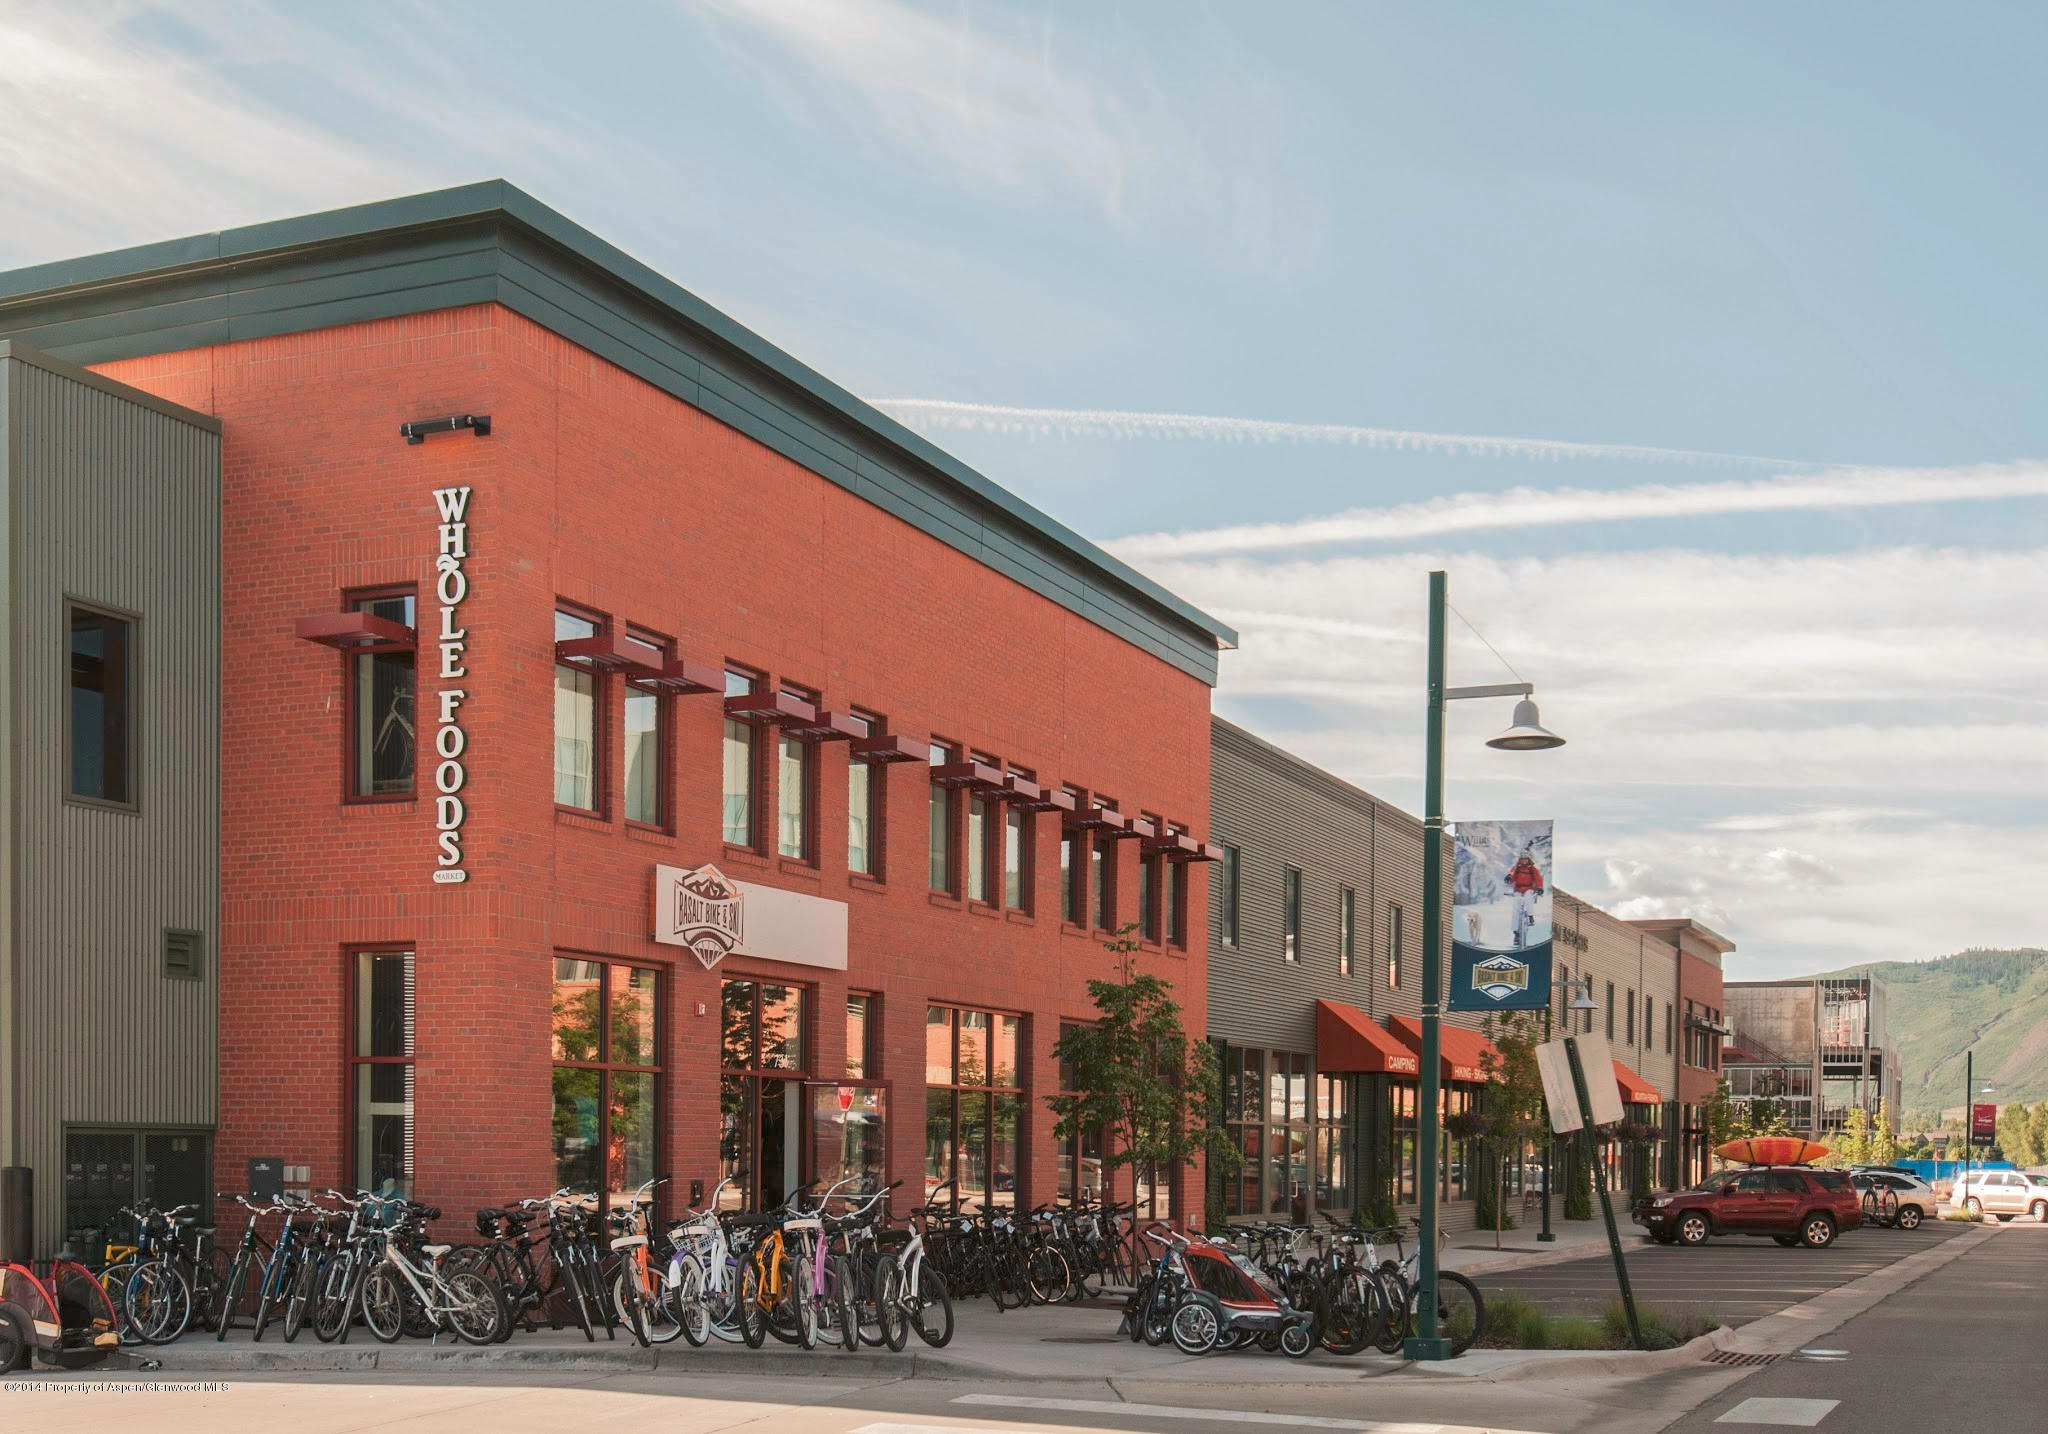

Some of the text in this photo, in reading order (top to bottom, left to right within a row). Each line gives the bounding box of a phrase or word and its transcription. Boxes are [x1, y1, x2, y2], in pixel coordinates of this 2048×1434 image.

[432, 486, 471, 867] WHOLE FOODS
[435, 872, 464, 881] MARKET
[679, 891, 704, 926] BASALT
[705, 903, 721, 926] BIKE
[729, 901, 740, 935] SKI
[1388, 1055, 1416, 1071] CAMPING
[1454, 1065, 1472, 1079] HIKING
